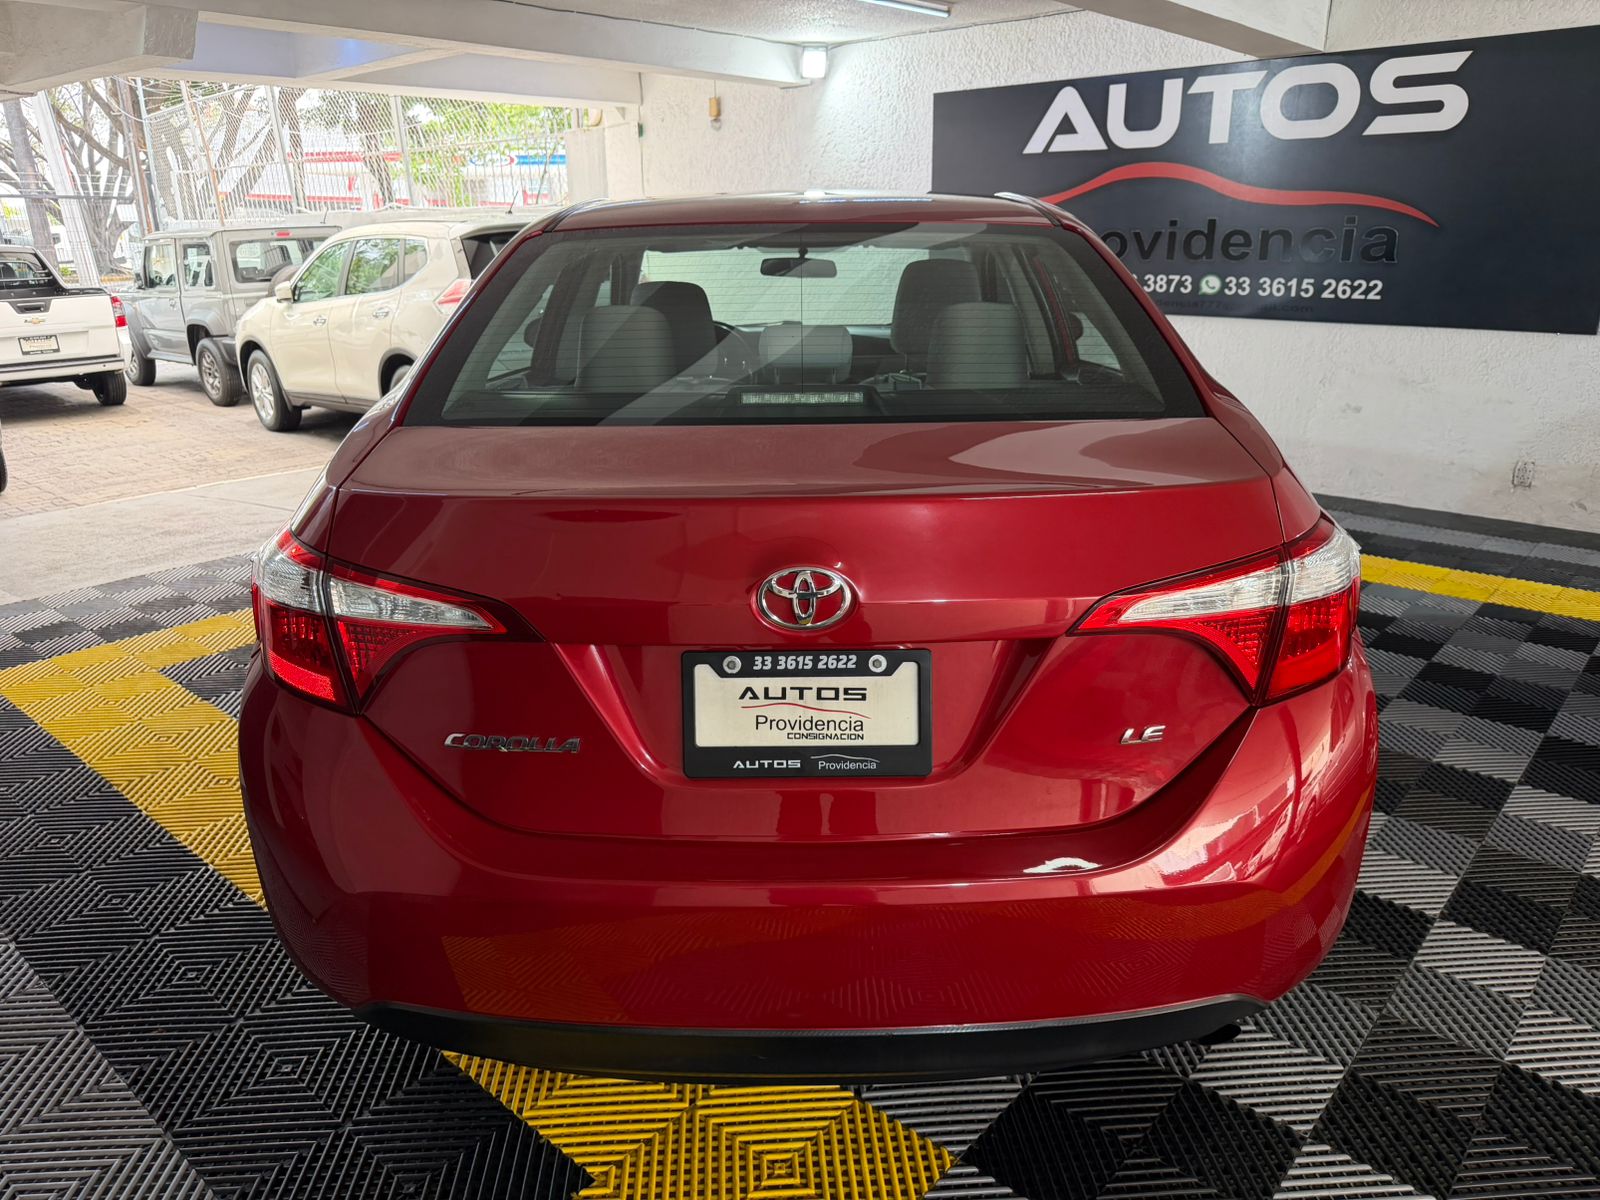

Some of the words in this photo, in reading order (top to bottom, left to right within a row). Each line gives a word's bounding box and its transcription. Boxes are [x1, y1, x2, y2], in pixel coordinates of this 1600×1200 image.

[1022, 50, 1474, 155] AUTOS
[1100, 214, 1399, 265] ovidencia
[1143, 274, 1193, 294] 3873
[1224, 276, 1251, 296] 33
[1258, 277, 1315, 298] 3615
[1321, 278, 1384, 300] 2622
[753, 656, 772, 670] 33
[777, 656, 813, 670] 3615
[818, 655, 857, 669] 2622
[738, 686, 867, 701] AUTOS
[755, 715, 864, 732] Providencia
[444, 733, 581, 754] COROLLA
[787, 732, 864, 741] CONSIGNACION
[1120, 725, 1166, 744] LE
[733, 760, 801, 769] AUTOS
[818, 761, 877, 770] Providencia
